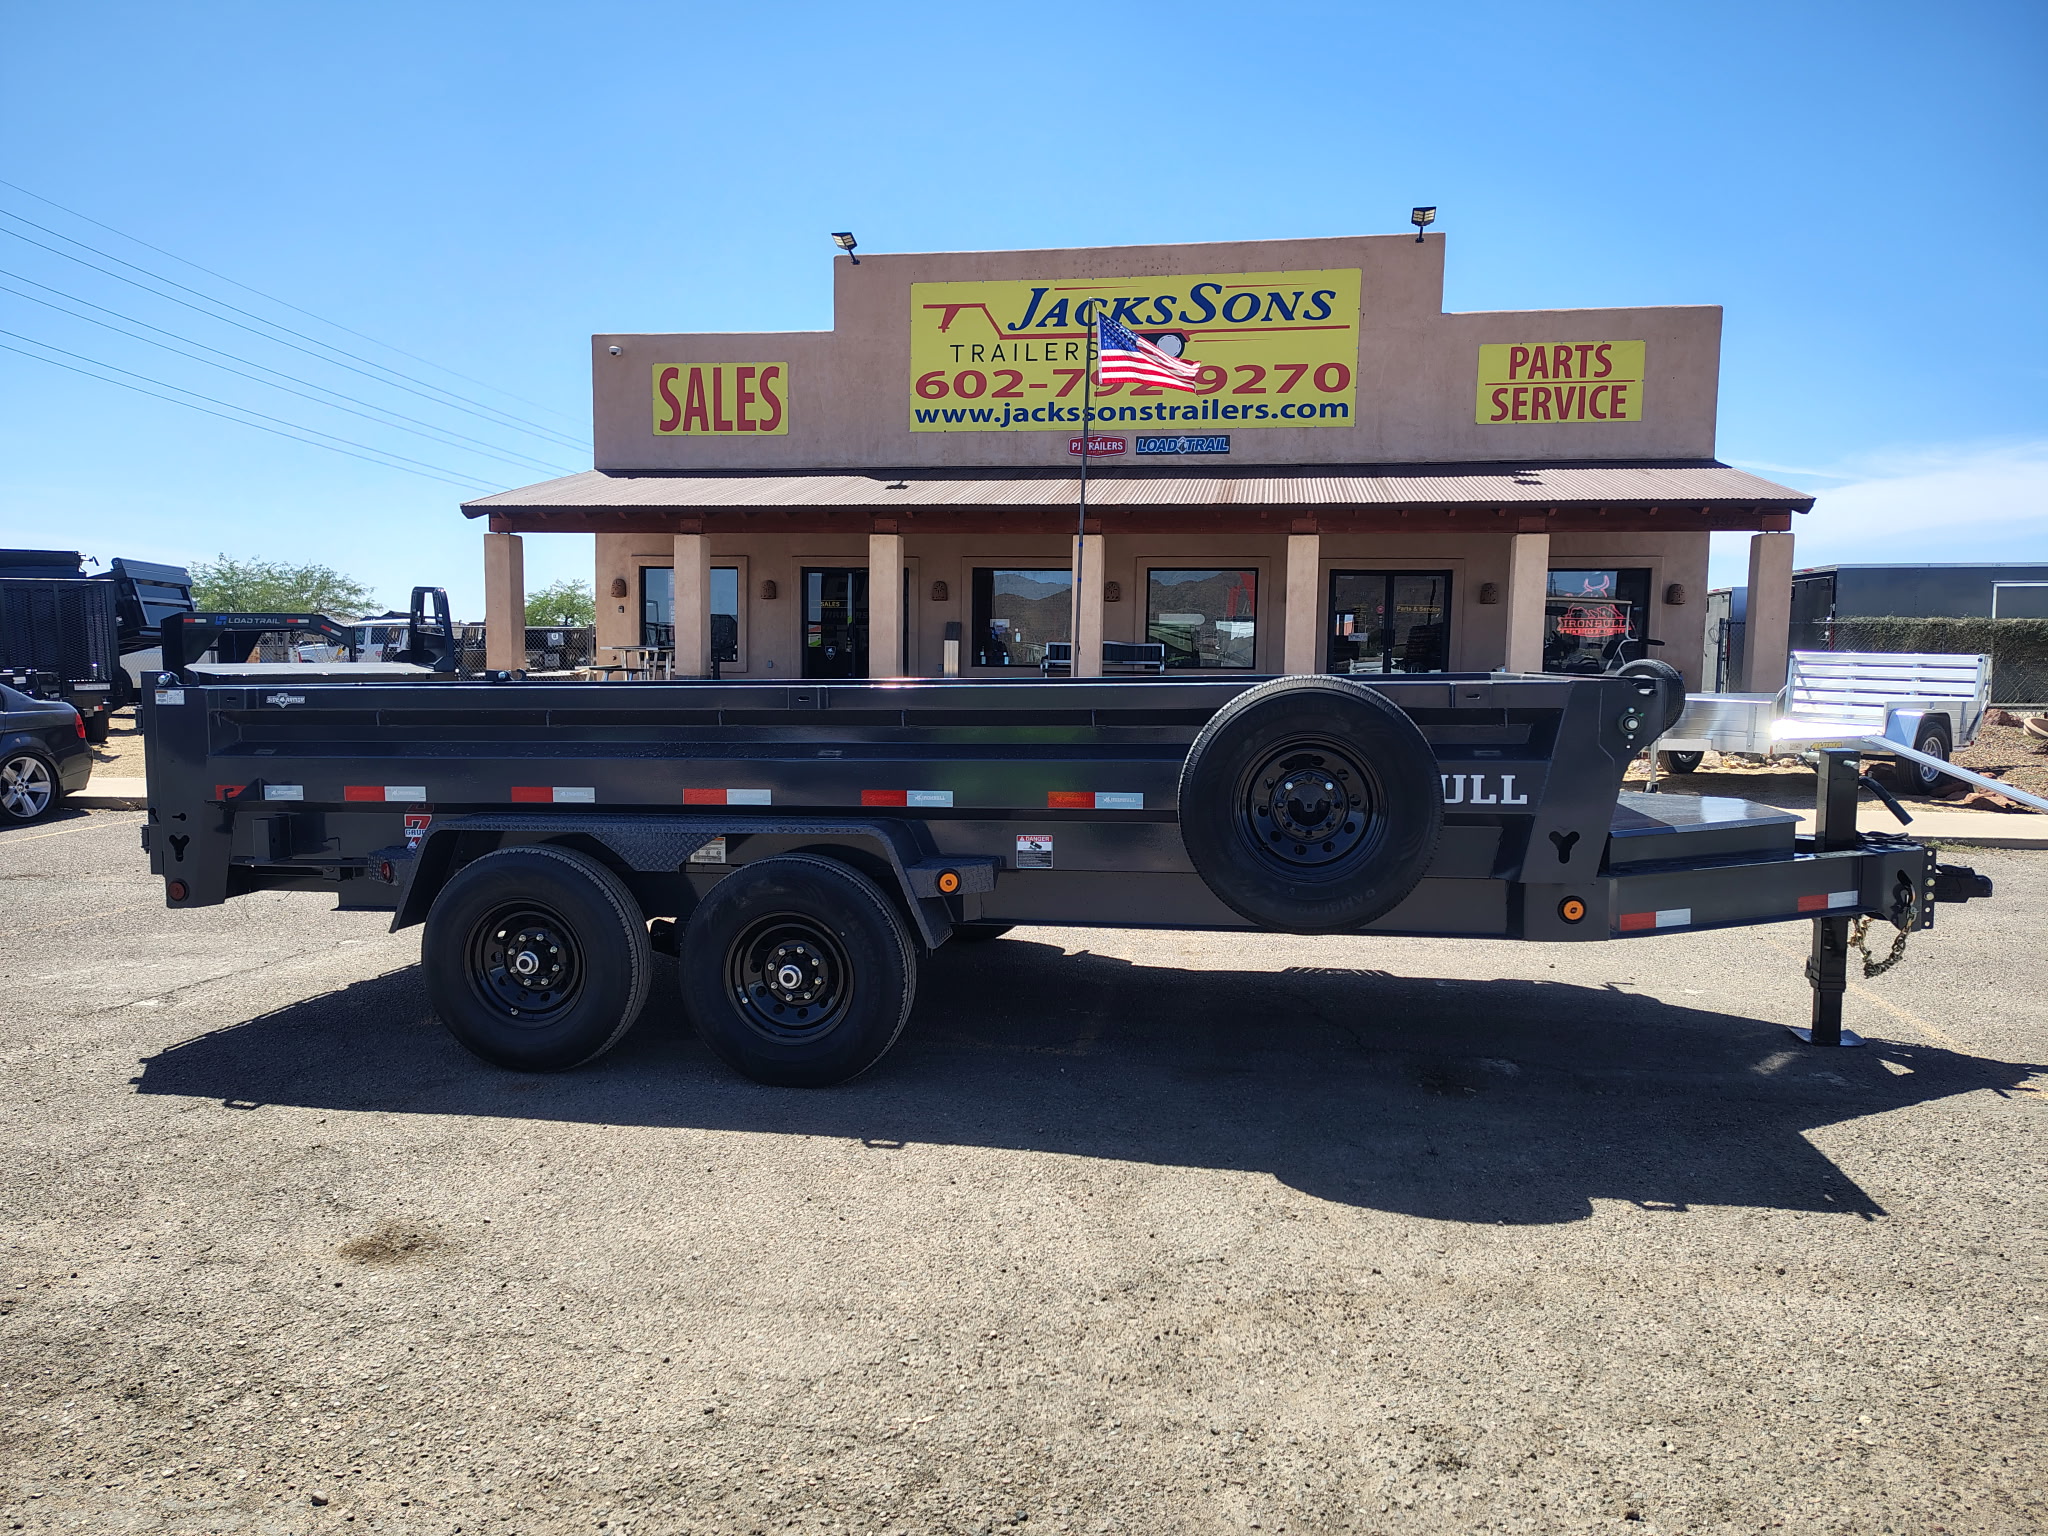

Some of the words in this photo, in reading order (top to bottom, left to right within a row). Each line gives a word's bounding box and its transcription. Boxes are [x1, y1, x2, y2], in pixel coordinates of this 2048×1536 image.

[950, 342, 1098, 362] TRAILERS
[1509, 344, 1612, 379] PARTS
[915, 362, 1351, 400] 602-799270
[659, 366, 781, 432] SALES
[915, 398, 1349, 428] www.jackssonstrailers.com
[1490, 385, 1627, 421] SERVICE
[1072, 441, 1081, 451] PJ
[1086, 441, 1123, 451] RAILERS
[1137, 439, 1178, 453] LOAD
[1186, 438, 1230, 452] TRAIL
